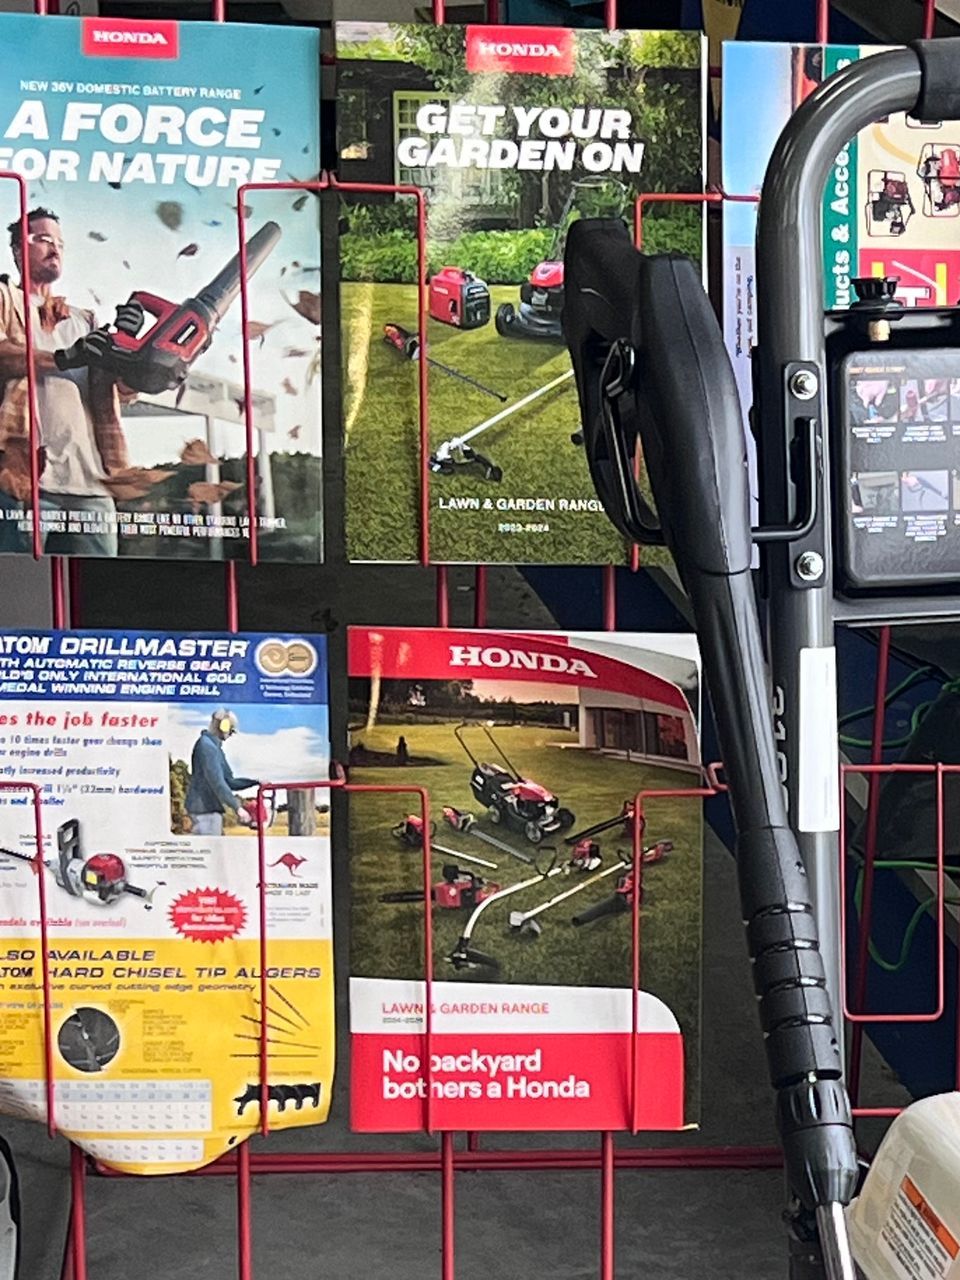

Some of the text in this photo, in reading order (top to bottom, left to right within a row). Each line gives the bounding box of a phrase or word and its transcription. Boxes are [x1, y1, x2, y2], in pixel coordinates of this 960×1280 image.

[93, 30, 168, 45] HONDA
[479, 42, 561, 57] HONDA
[20, 80, 242, 100] NEW 36V DOMESTIC BATTERY RANGE
[4, 100, 265, 149] A FORCE
[416, 104, 632, 139] GET YOUR
[397, 137, 645, 173] GARDEN ON
[88, 150, 282, 187] NATURE
[439, 497, 480, 510] LAWN
[482, 498, 494, 510] &
[496, 498, 556, 511] GARDEN
[0, 636, 248, 657] TOM DRILLMASTER
[24, 658, 114, 670] AUTOMATIC
[117, 659, 186, 671] REVERSE
[190, 660, 232, 671] GEAR
[449, 645, 598, 678] HONDA
[38, 670, 80, 682] ONLY
[84, 671, 202, 683] INTERNATIONAL
[206, 673, 247, 684] GOLD
[51, 683, 116, 694] WINNING
[120, 684, 176, 696] ENGINE
[180, 685, 220, 696] DRILL
[26, 711, 57, 726] the
[63, 711, 93, 730] job
[101, 711, 159, 727] faster
[10, 734, 21, 745] 10
[24, 734, 50, 745] times
[83, 738, 104, 747] gear
[141, 737, 163, 746] than
[19, 766, 63, 775] increased
[65, 766, 121, 777] productivity
[118, 785, 164, 794] hardwood
[48, 950, 156, 961] AVAILABLE
[0, 967, 33, 978] TOM
[113, 967, 186, 978] CHISEL
[195, 967, 226, 978] TIP
[382, 1002, 550, 1014] LAWN GARDEN RANGE
[383, 1049, 420, 1072] No
[487, 1081, 502, 1099] a
[507, 1075, 590, 1099] Honda
